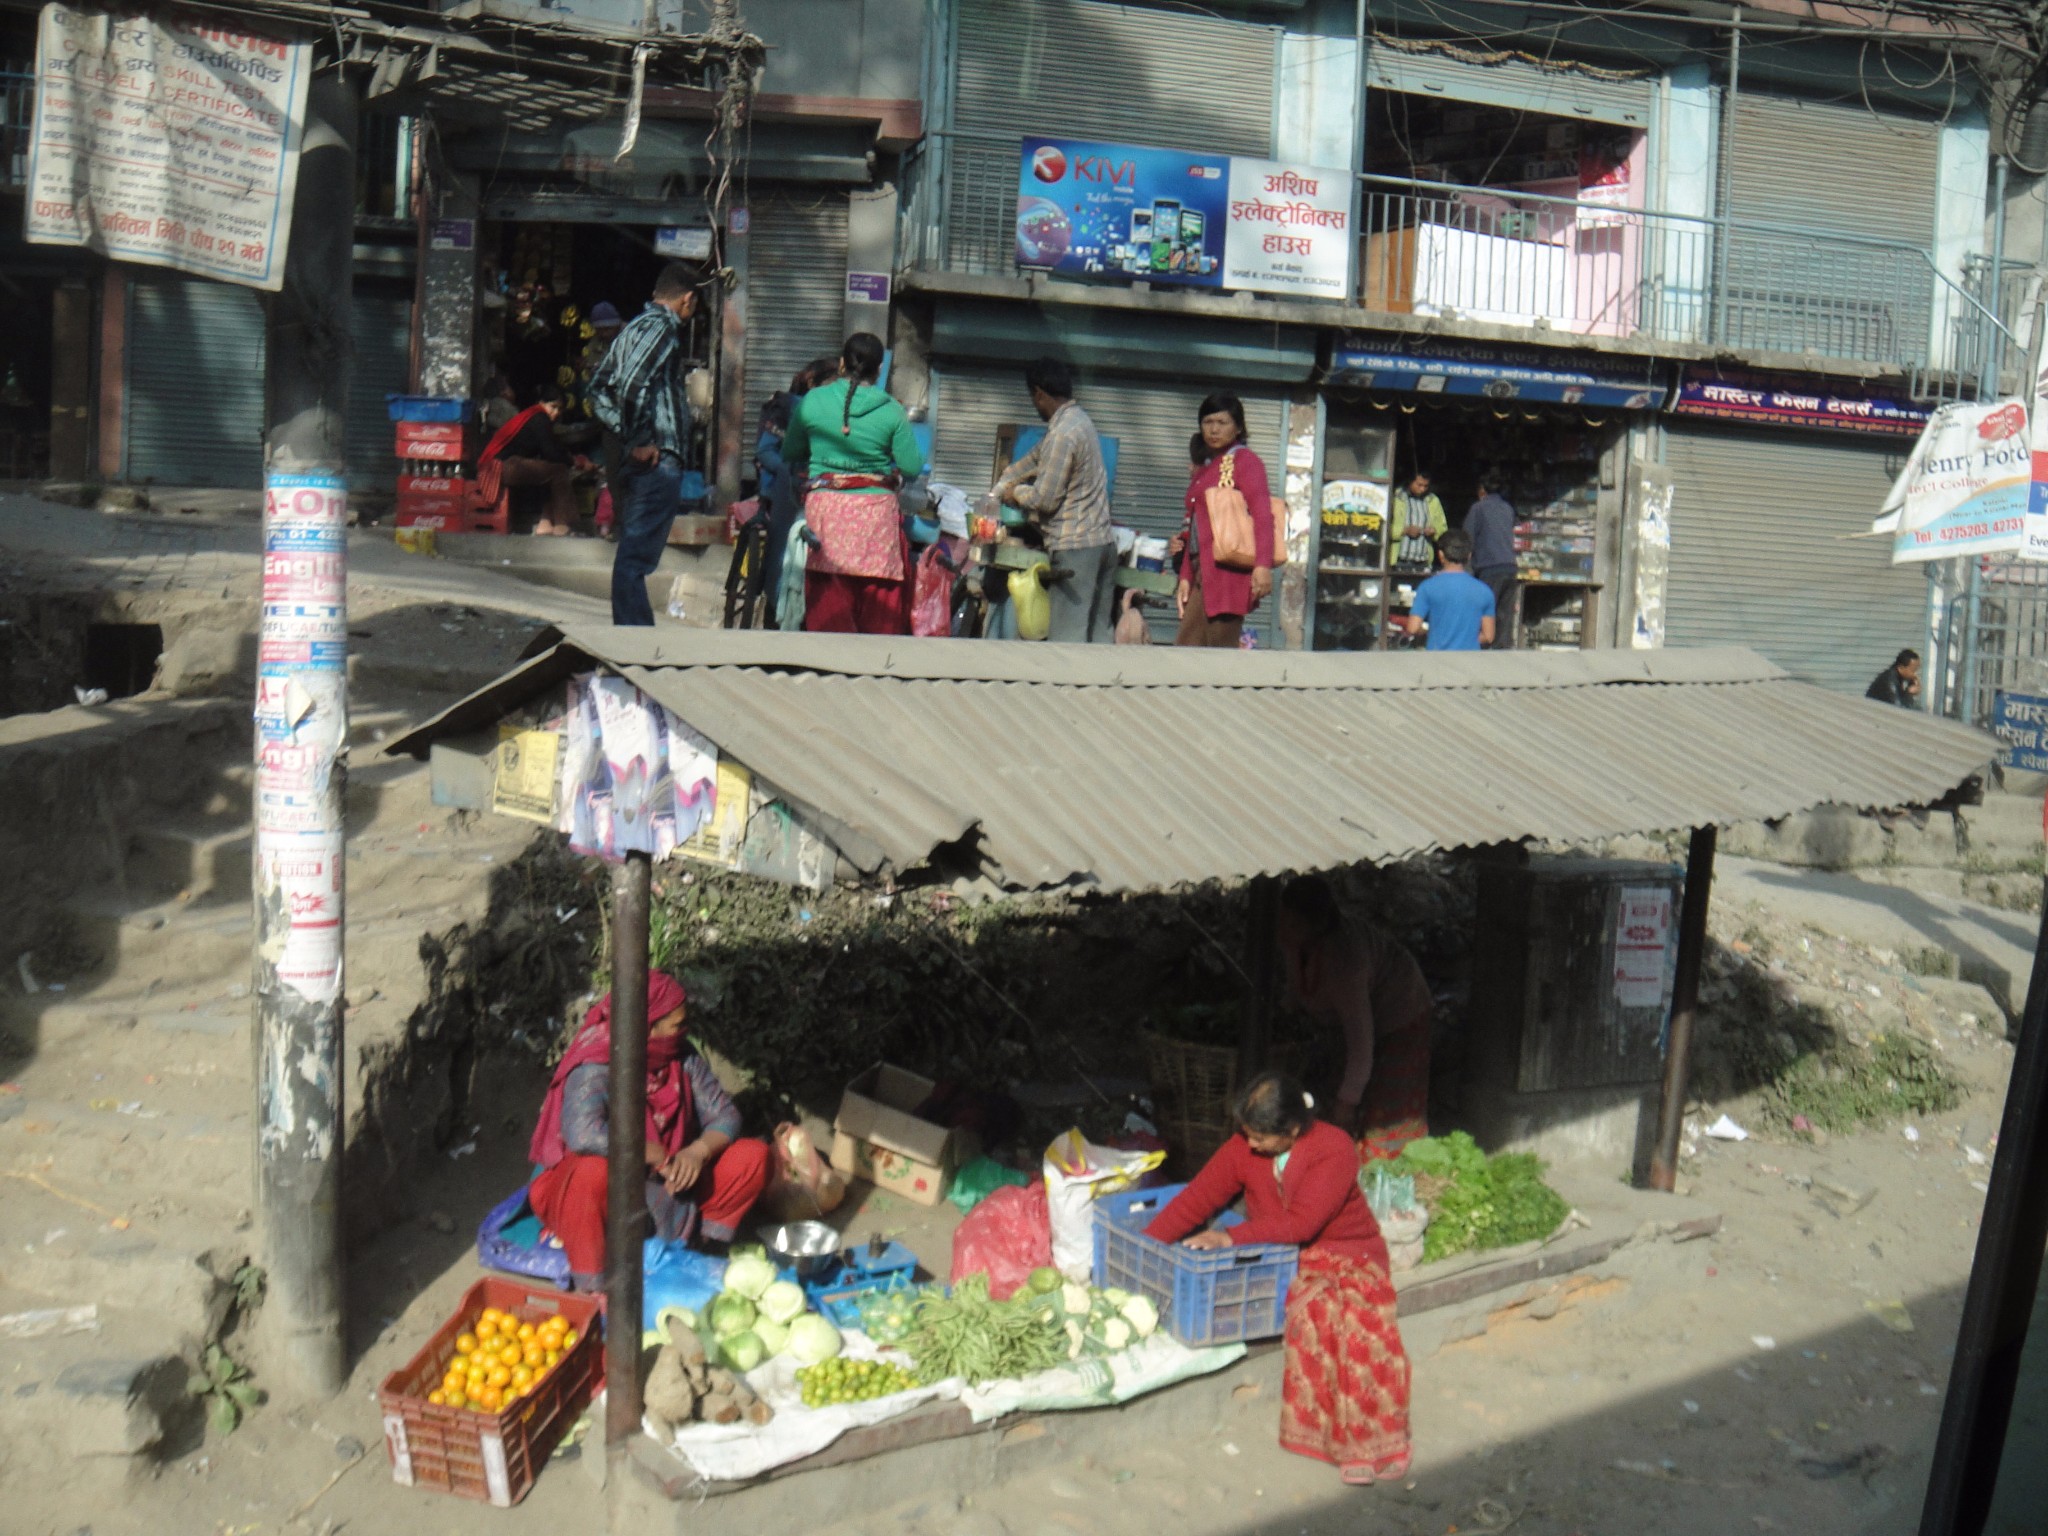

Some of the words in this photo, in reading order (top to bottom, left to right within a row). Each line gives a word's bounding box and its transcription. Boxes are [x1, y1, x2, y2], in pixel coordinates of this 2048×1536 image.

[163, 65, 217, 90] SKILL
[222, 79, 265, 102] TEST
[83, 65, 142, 93] LEVEL
[162, 85, 282, 128] CERTIFICATE
[1074, 155, 1136, 187] KIVI
[1264, 170, 1319, 197] अशिष
[1231, 197, 1347, 229] इलेक्ट्रोनिक्स
[1263, 234, 1312, 255] हाउस
[1703, 384, 1767, 408] मास्टर
[407, 441, 447, 456] Coca-Cola
[1983, 446, 2030, 470] Ford
[409, 479, 450, 491] Coca-Cola
[1941, 477, 1989, 491] College
